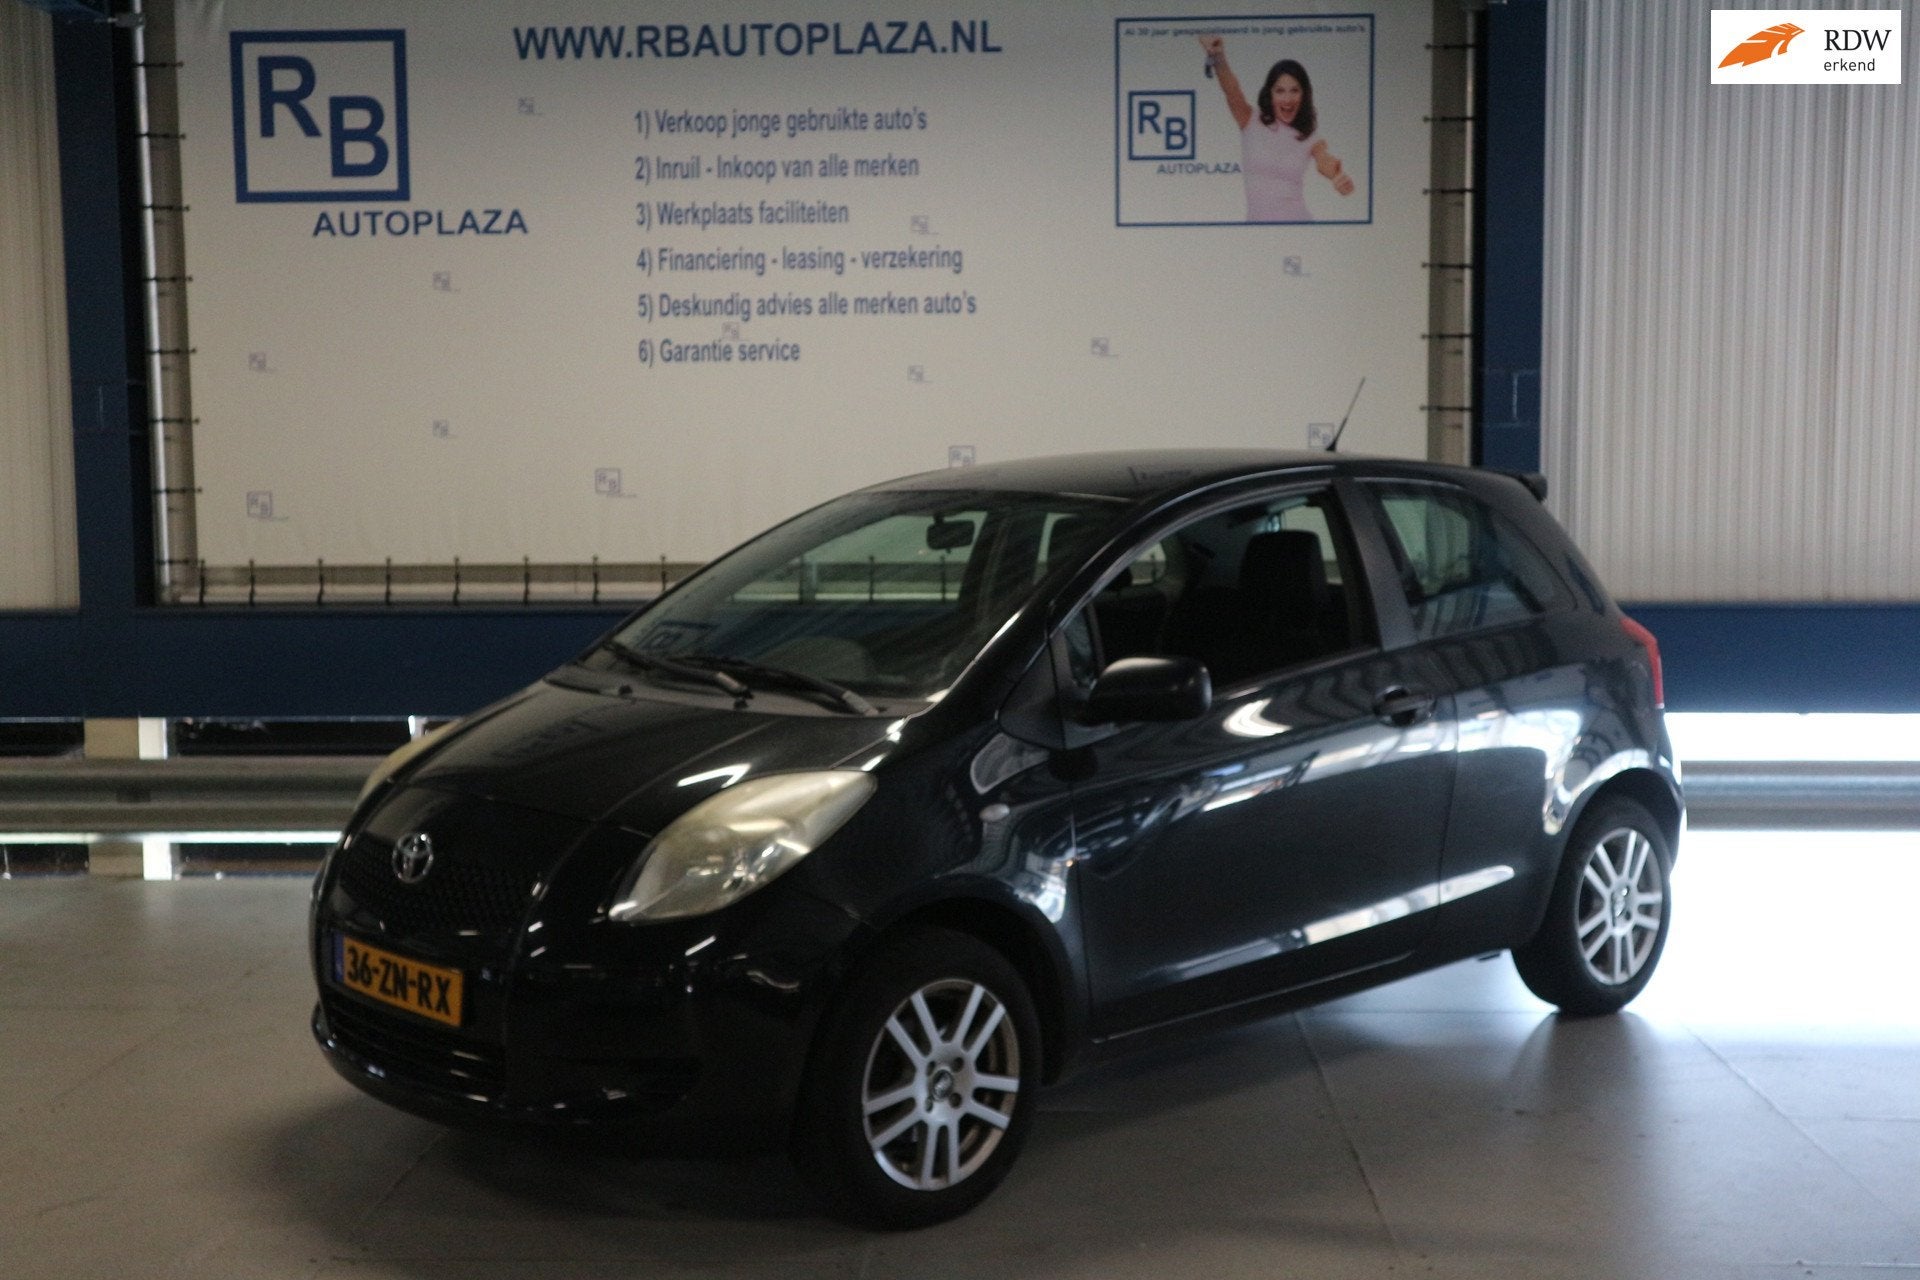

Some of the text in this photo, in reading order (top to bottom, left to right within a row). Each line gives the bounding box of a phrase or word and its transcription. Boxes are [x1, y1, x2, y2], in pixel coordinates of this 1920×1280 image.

[513, 20, 1004, 60] WWW.RBAUTOPLAZA.NL
[634, 105, 928, 139] 1) Verkoop jonge gebruikte auto's
[635, 154, 652, 185] 2)
[656, 154, 701, 179] Inruil
[717, 153, 777, 183] Inkoop
[781, 159, 813, 178] van
[818, 152, 849, 178] alle
[854, 152, 919, 177] merken
[1156, 162, 1242, 176] AUTOPLAZA
[312, 208, 529, 238] AUTOPLAZA
[636, 198, 849, 231] 3) Werkplaats faciliteiten
[636, 247, 652, 277] 4)
[658, 246, 766, 276] Financiering
[782, 246, 845, 276] leasing
[861, 244, 963, 275] verzekering
[638, 289, 977, 323] 5) Deskundig advies alle merken auto's
[638, 337, 800, 369] 6) Garantie service
[346, 946, 452, 1017] 36-ZN-RX
